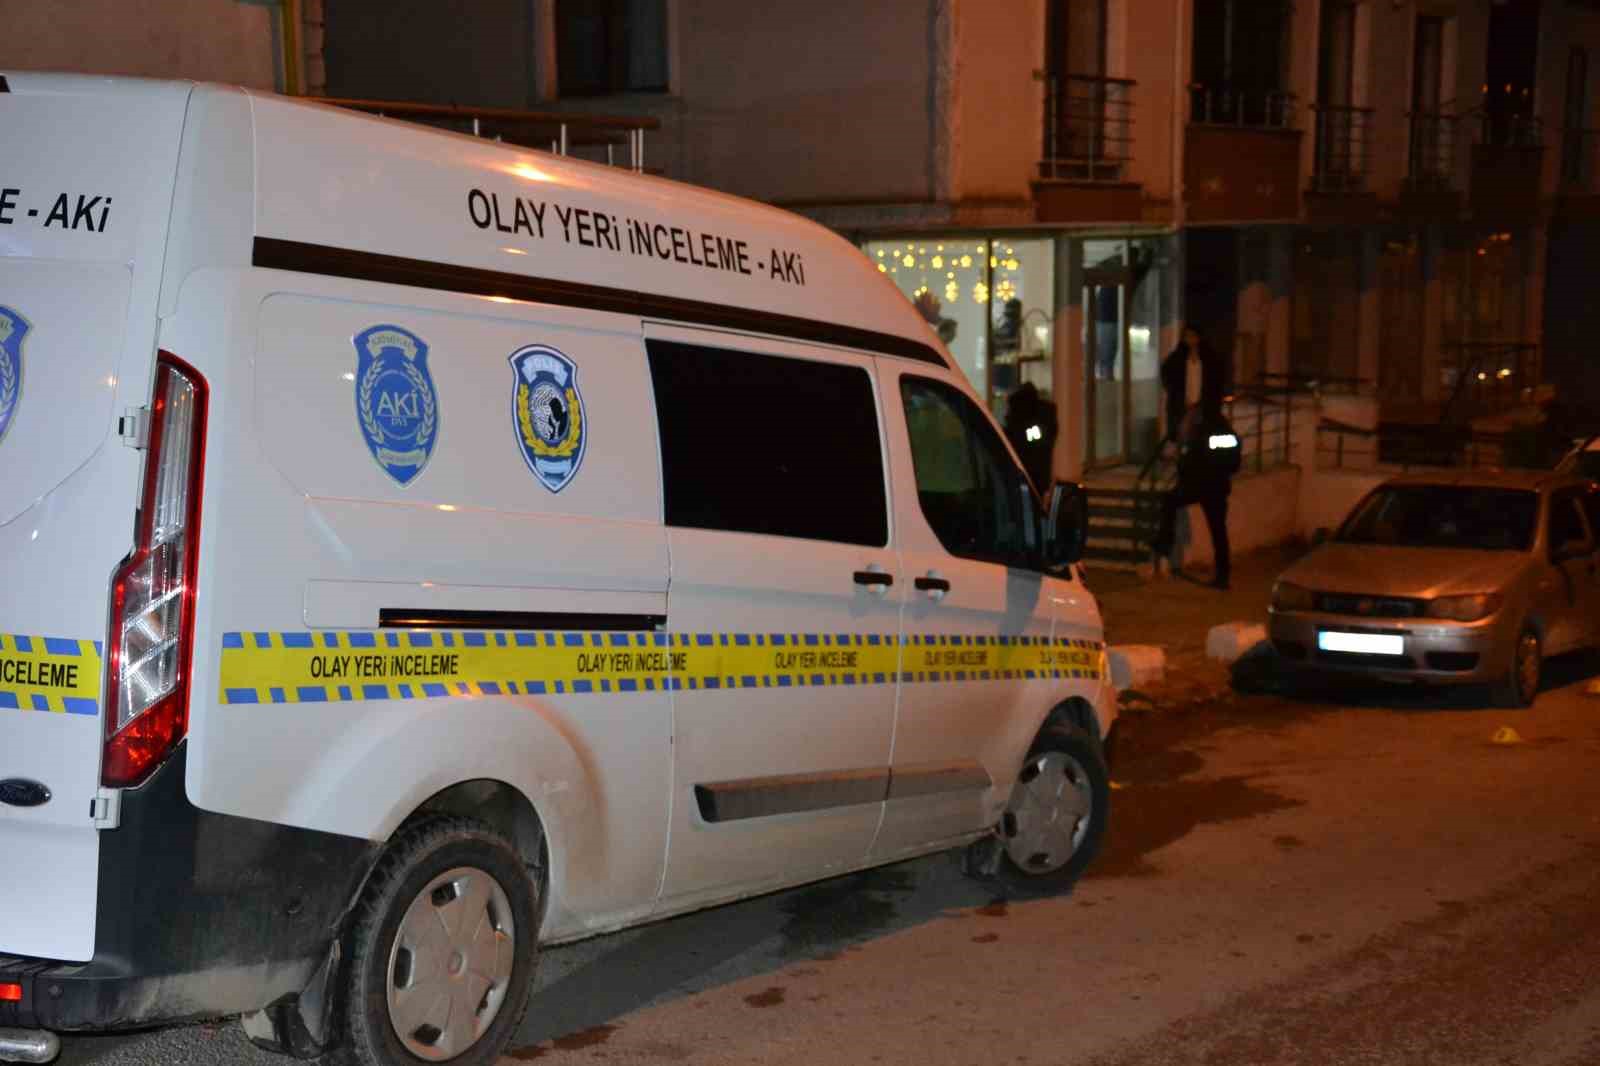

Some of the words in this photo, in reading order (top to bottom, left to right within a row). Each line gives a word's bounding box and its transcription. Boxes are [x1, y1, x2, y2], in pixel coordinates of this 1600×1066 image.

[468, 188, 546, 239] OLAY
[310, 655, 351, 679] OLAY
[576, 652, 608, 673] OLAY
